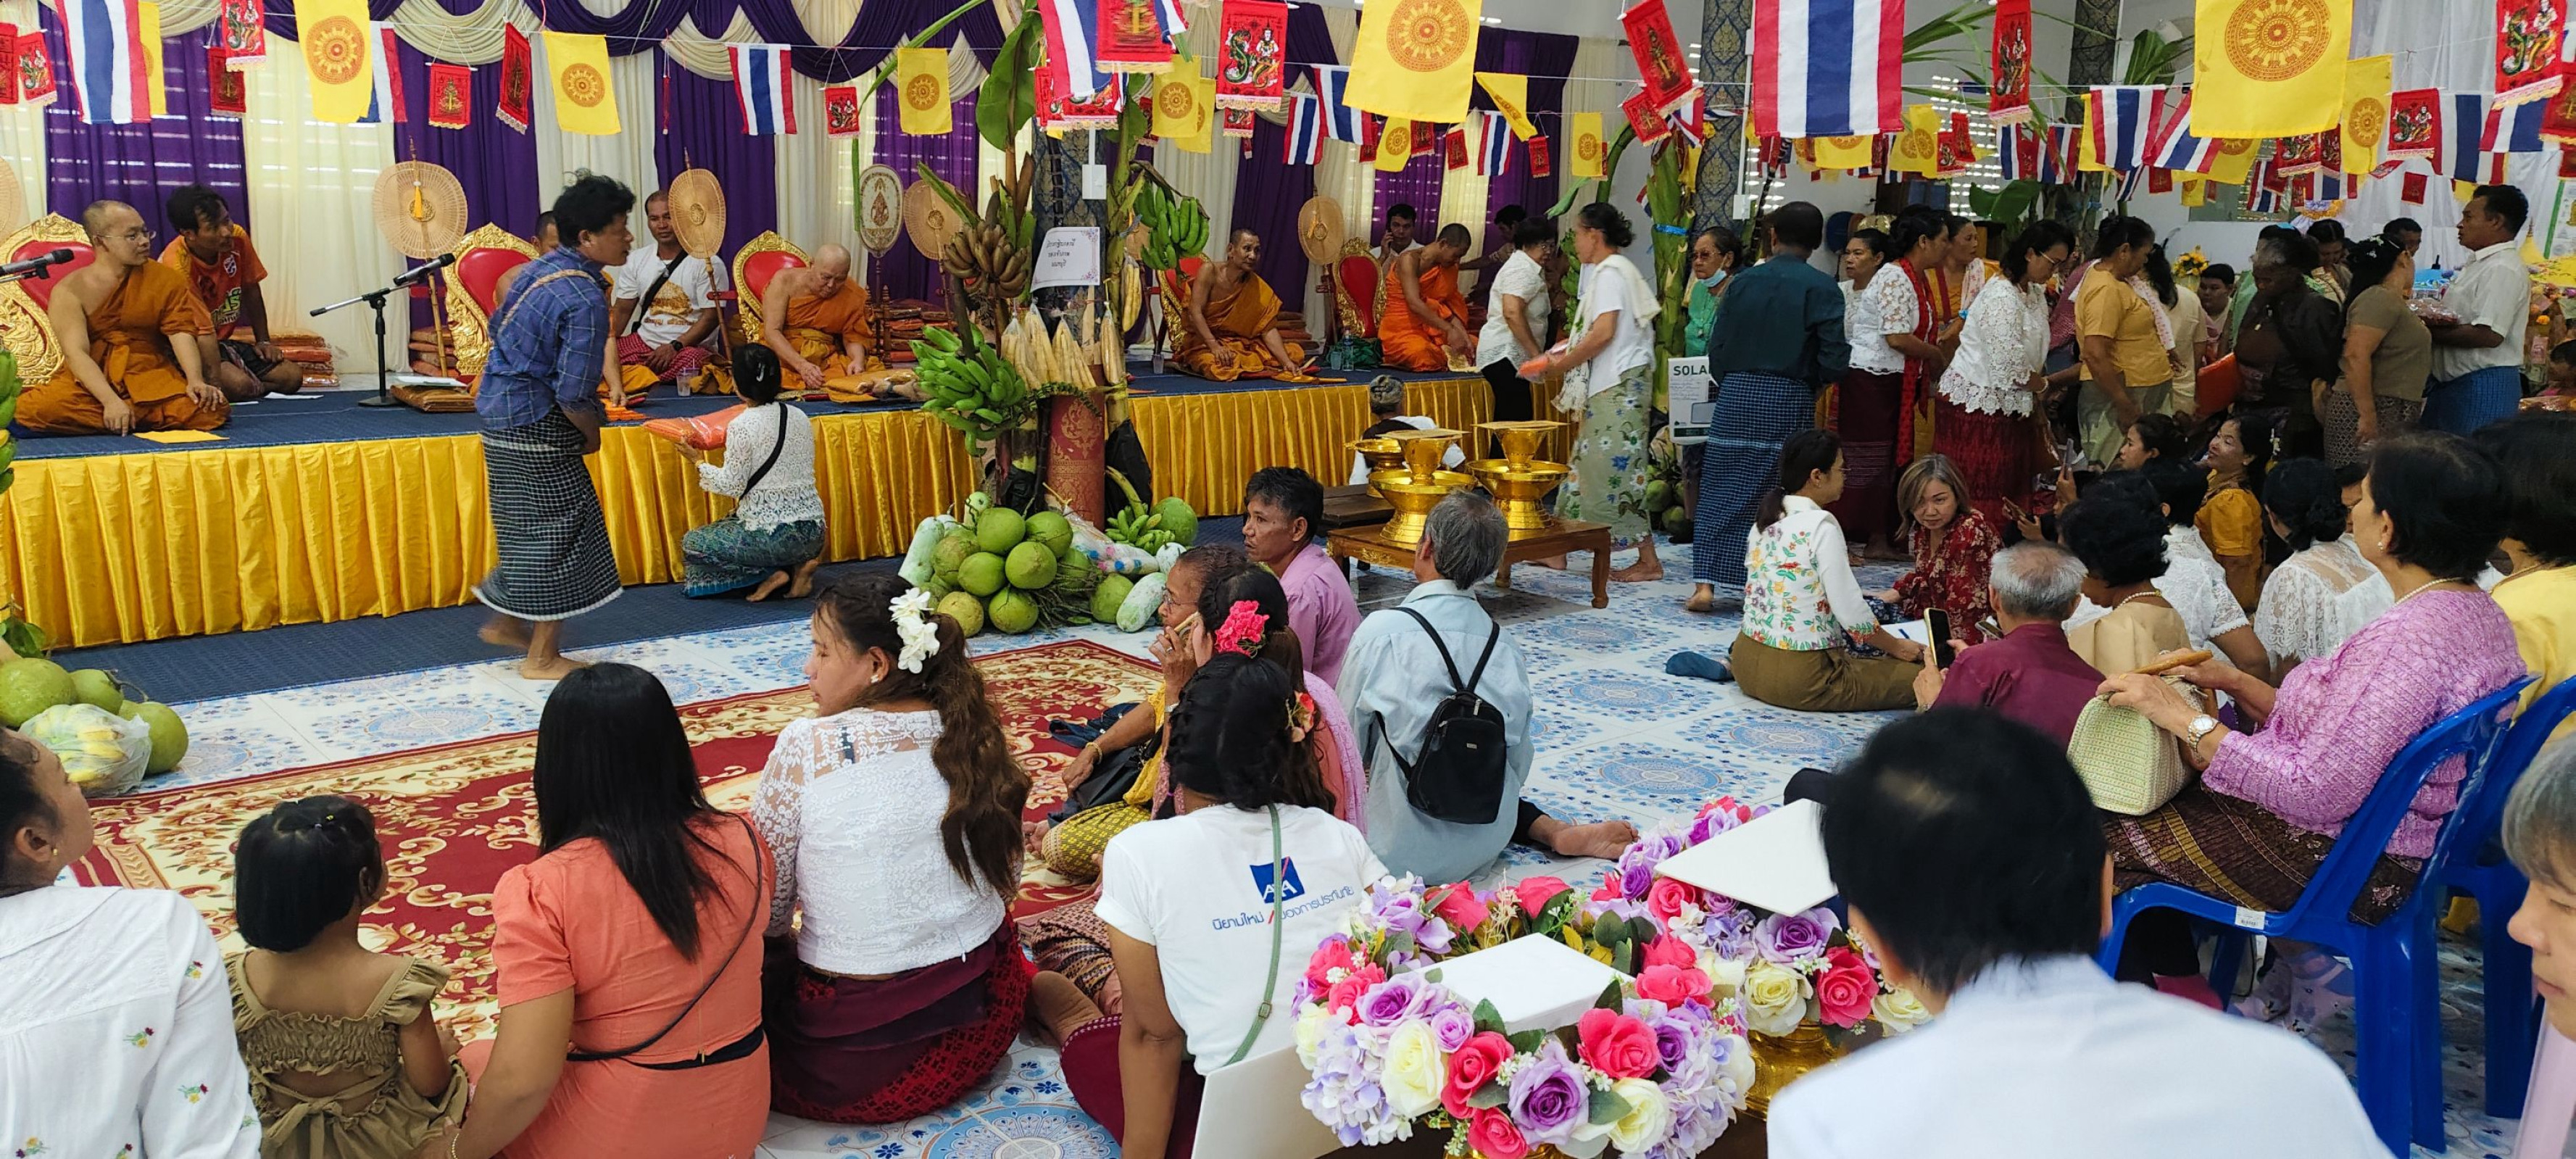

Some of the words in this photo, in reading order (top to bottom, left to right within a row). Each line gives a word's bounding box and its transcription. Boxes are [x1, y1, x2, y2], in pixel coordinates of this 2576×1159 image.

[1673, 365, 1708, 376] SOLA
[1212, 912, 1265, 931] นิยามใหม่
